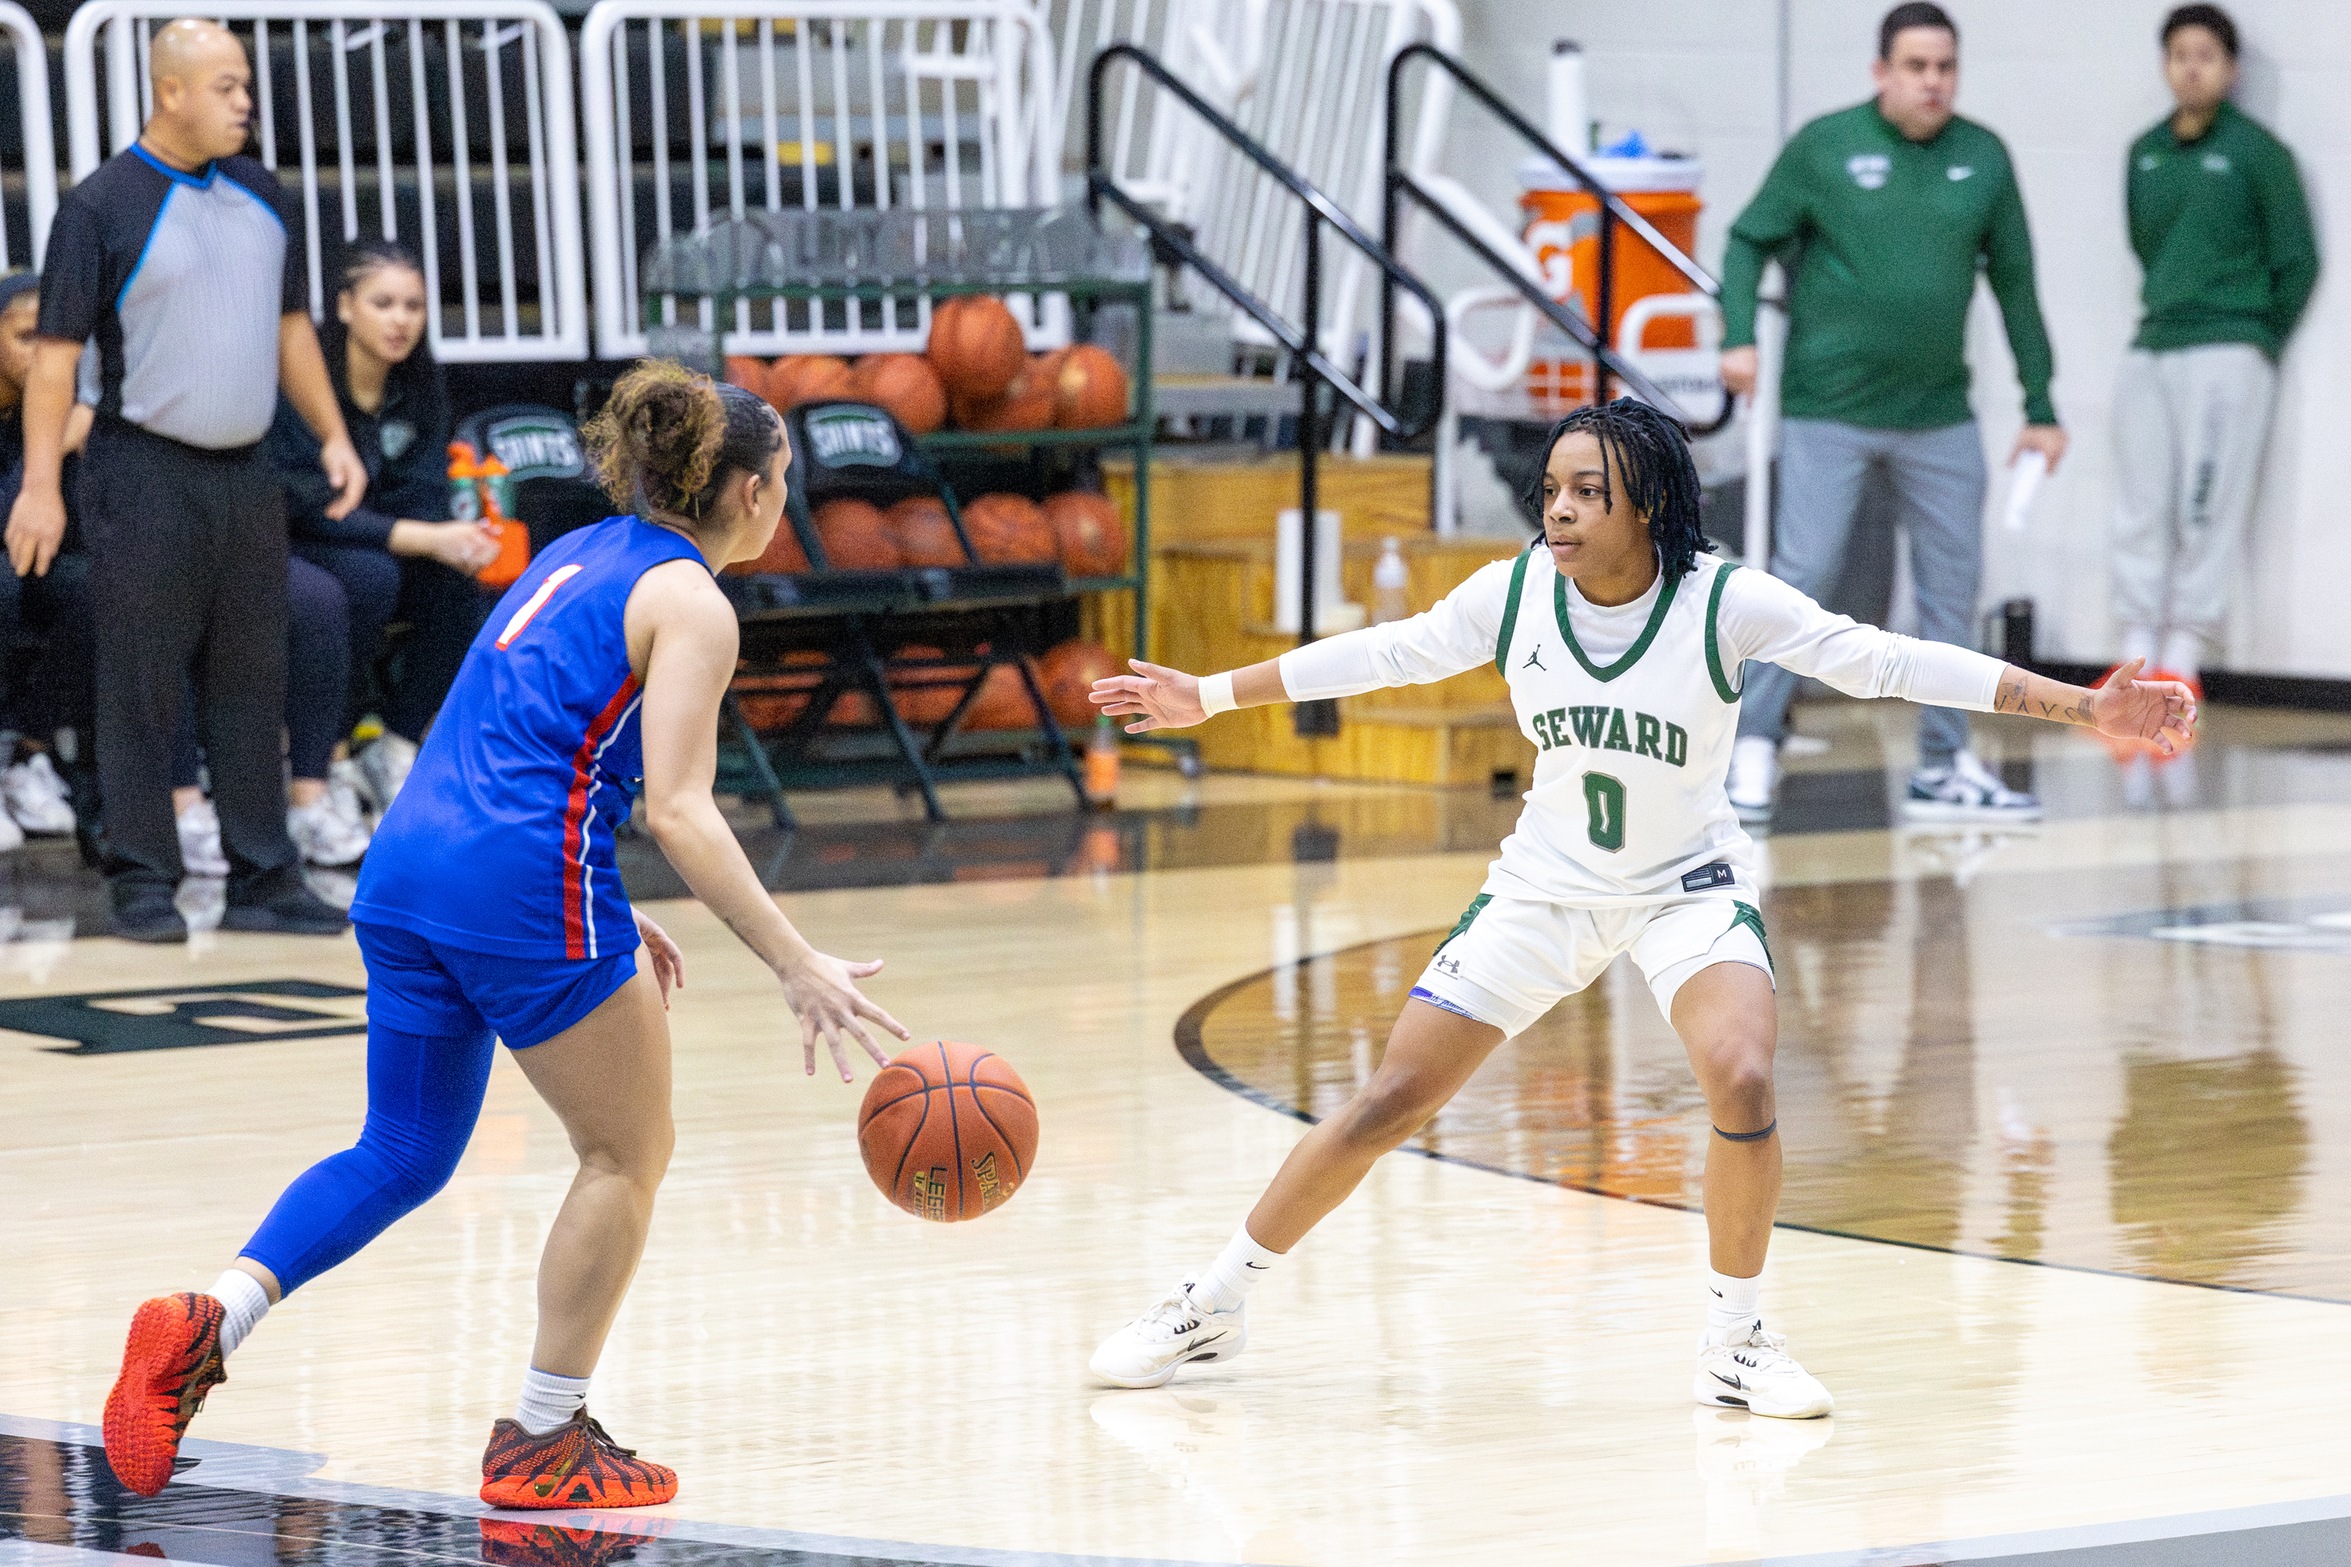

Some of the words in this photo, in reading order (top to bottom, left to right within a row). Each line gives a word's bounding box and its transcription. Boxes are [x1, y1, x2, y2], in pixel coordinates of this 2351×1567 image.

[494, 563, 584, 652] 1
[1532, 705, 1688, 768] SEWARD
[1581, 770, 1627, 854] 0
[1716, 869, 1728, 879] M
